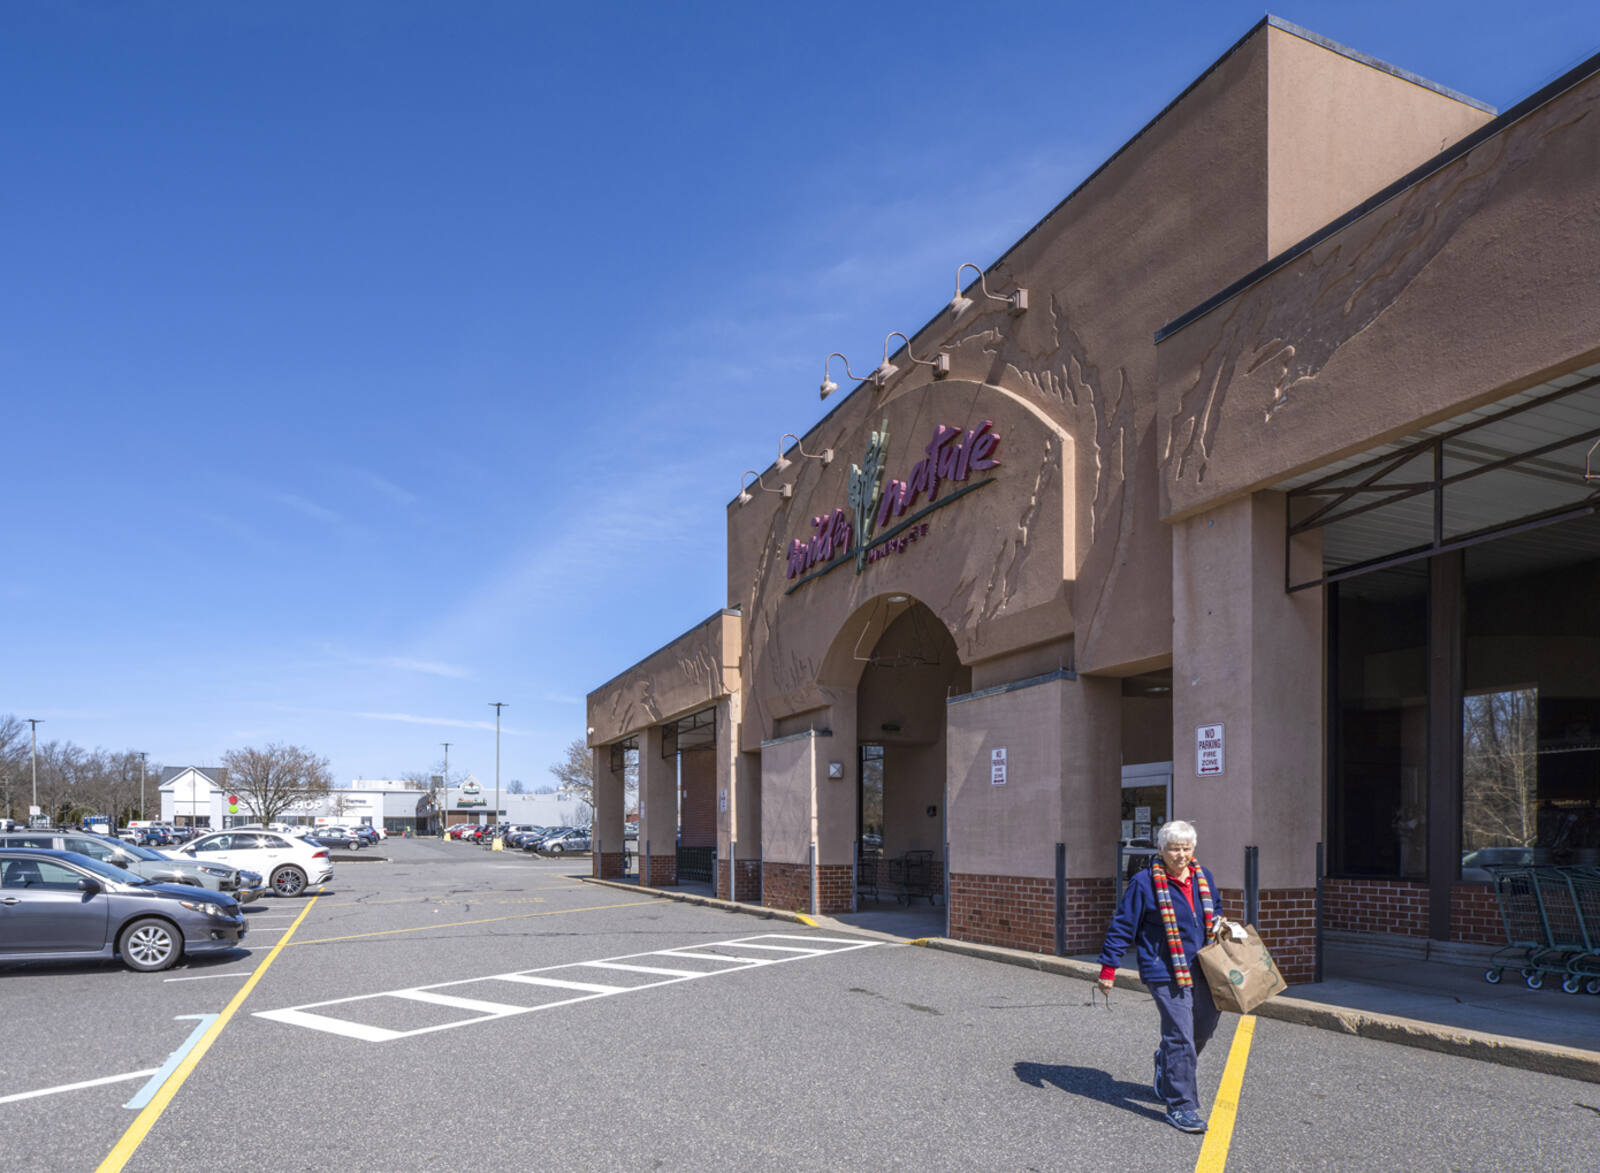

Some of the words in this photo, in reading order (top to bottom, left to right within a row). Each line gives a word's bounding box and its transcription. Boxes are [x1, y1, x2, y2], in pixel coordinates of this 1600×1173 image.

[876, 420, 1001, 527] nature
[1204, 728, 1215, 739] NO
[1199, 739, 1221, 749] PARKING
[1201, 759, 1218, 767] ZONE
